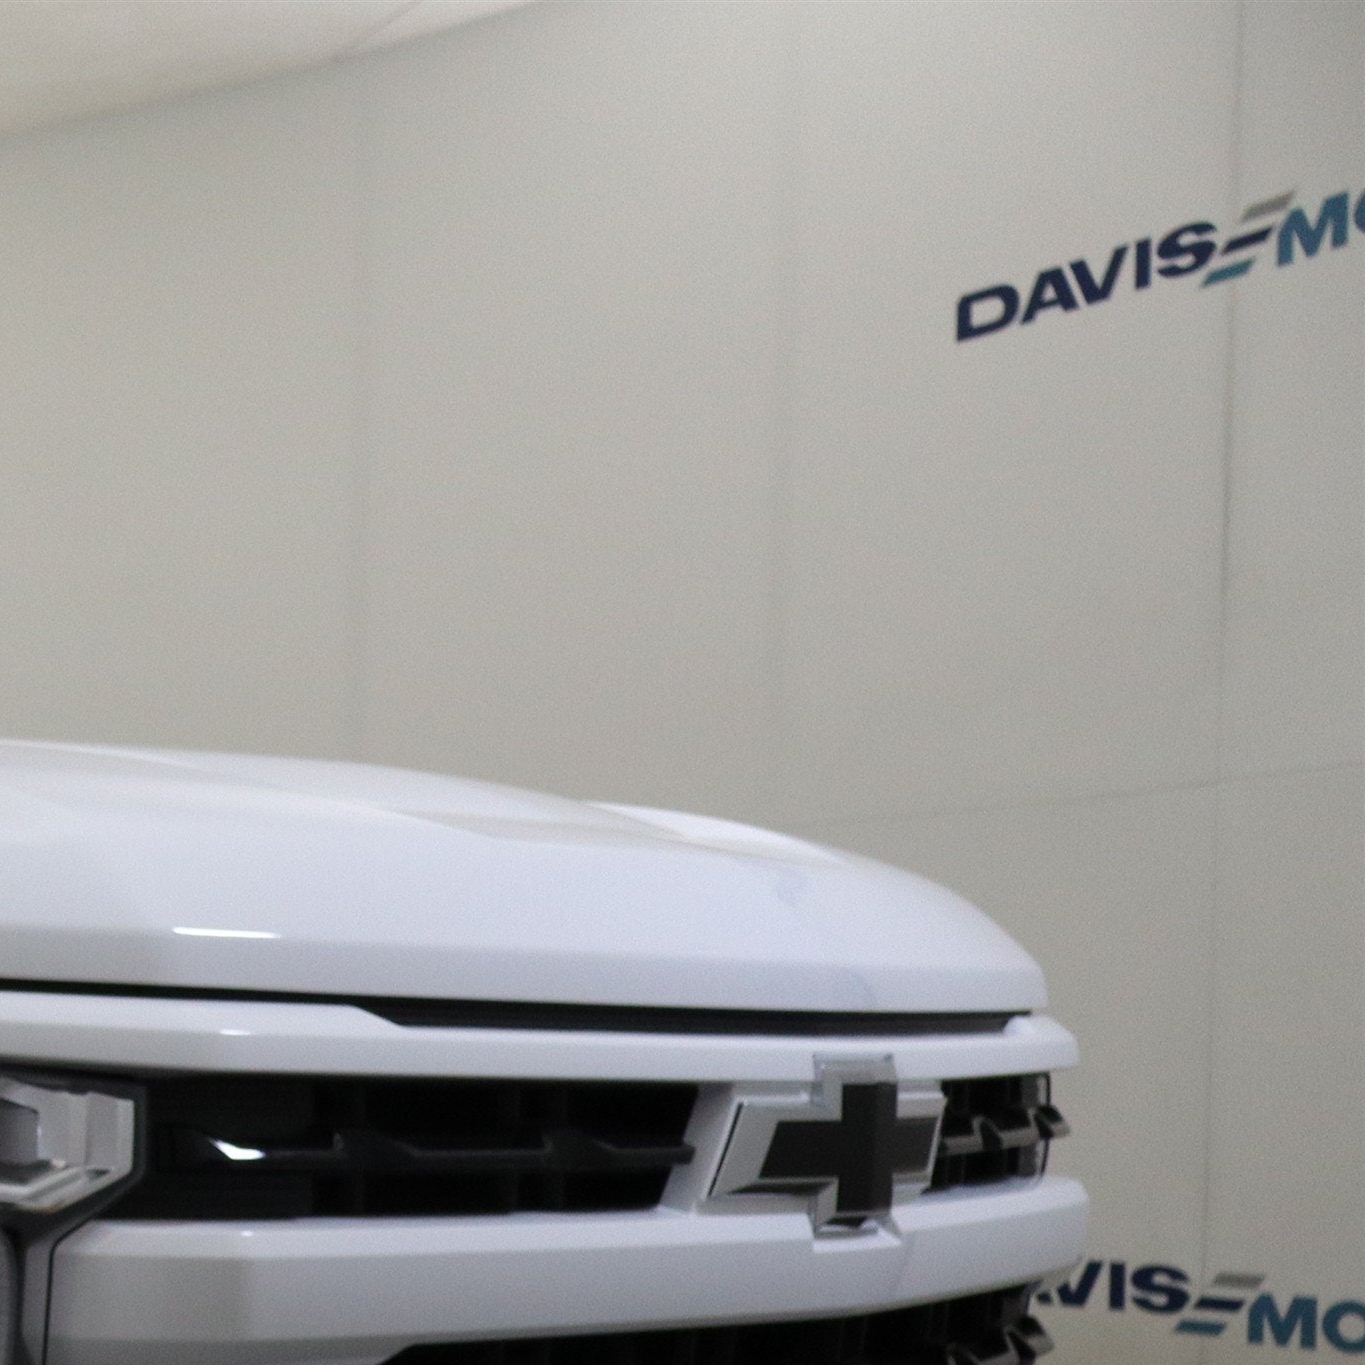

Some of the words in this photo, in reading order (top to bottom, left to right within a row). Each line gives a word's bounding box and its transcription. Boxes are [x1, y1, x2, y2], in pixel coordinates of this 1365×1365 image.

[954, 219, 1219, 344] DAVIS
[1276, 189, 1365, 268] M
[1035, 1259, 1192, 1316] VIS
